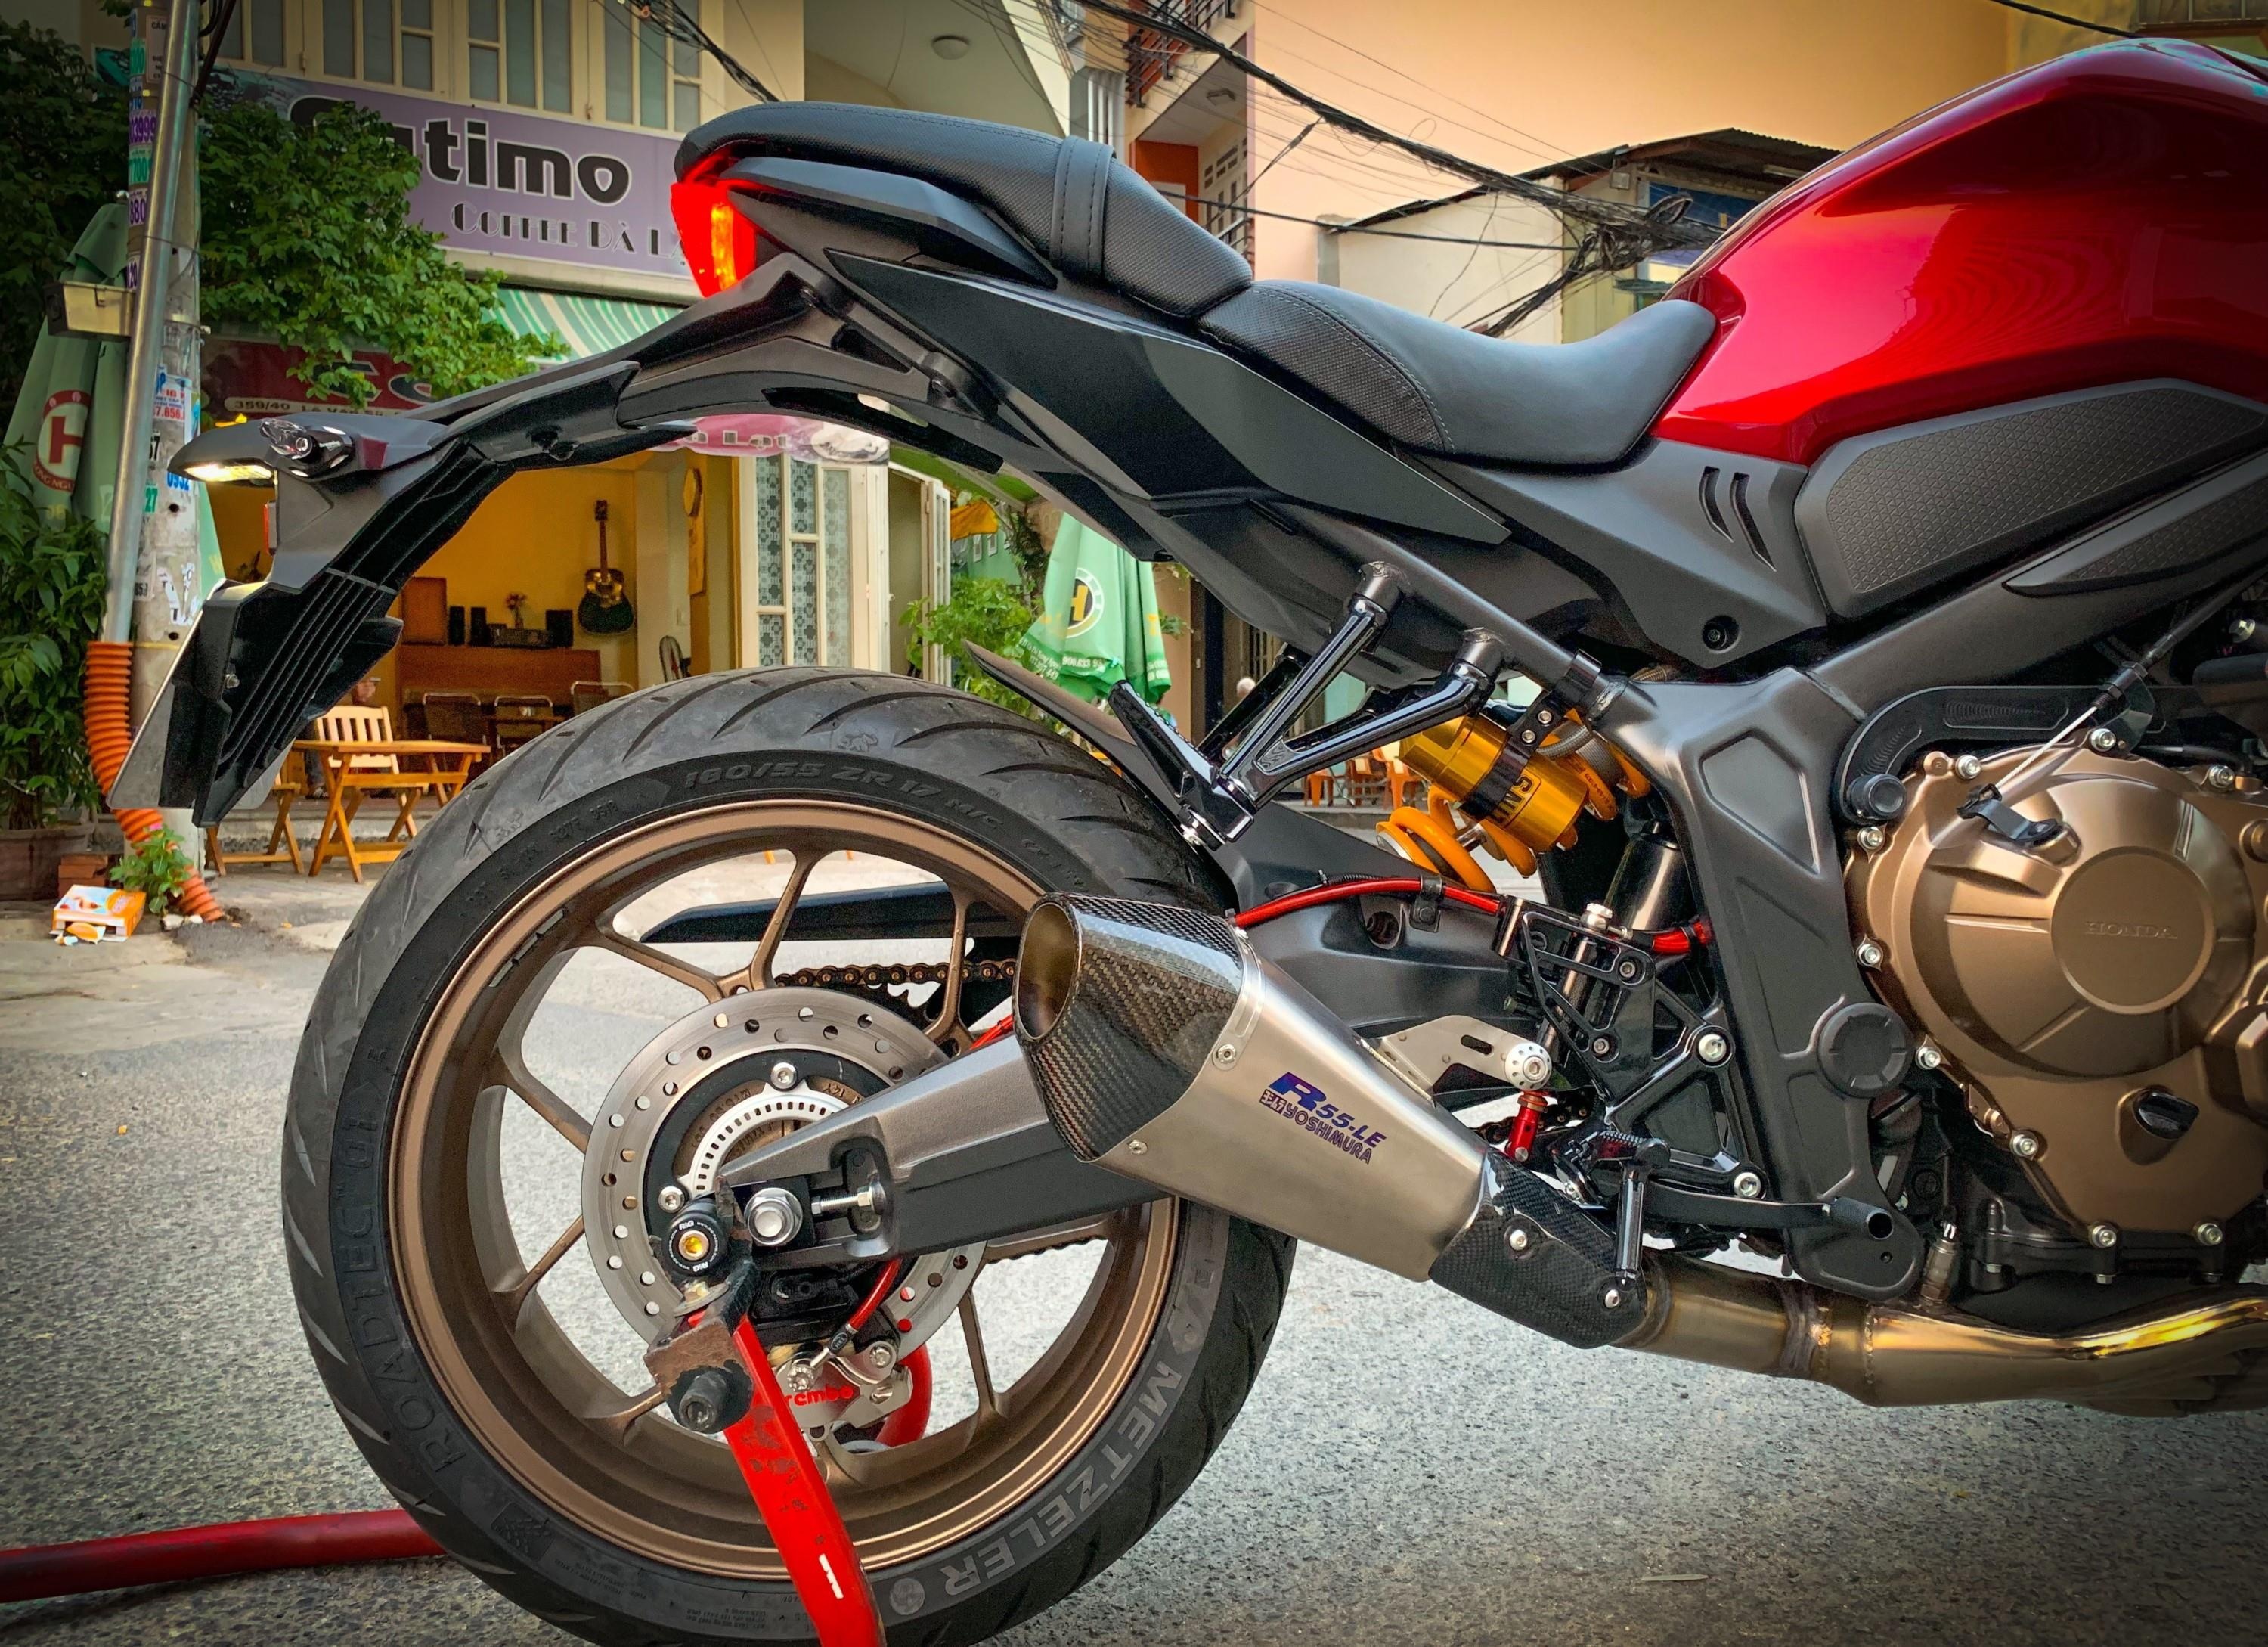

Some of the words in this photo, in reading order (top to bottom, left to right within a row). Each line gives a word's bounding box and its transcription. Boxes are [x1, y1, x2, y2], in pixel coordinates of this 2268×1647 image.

[234, 399, 290, 411] 359/40
[832, 766, 891, 789] ZR
[898, 779, 943, 799] 17
[2084, 920, 2178, 940] HONDA
[1282, 1102, 1373, 1165] YOSHIMURA
[784, 1384, 855, 1407] rembo
[940, 1360, 1182, 1596] METZELER
